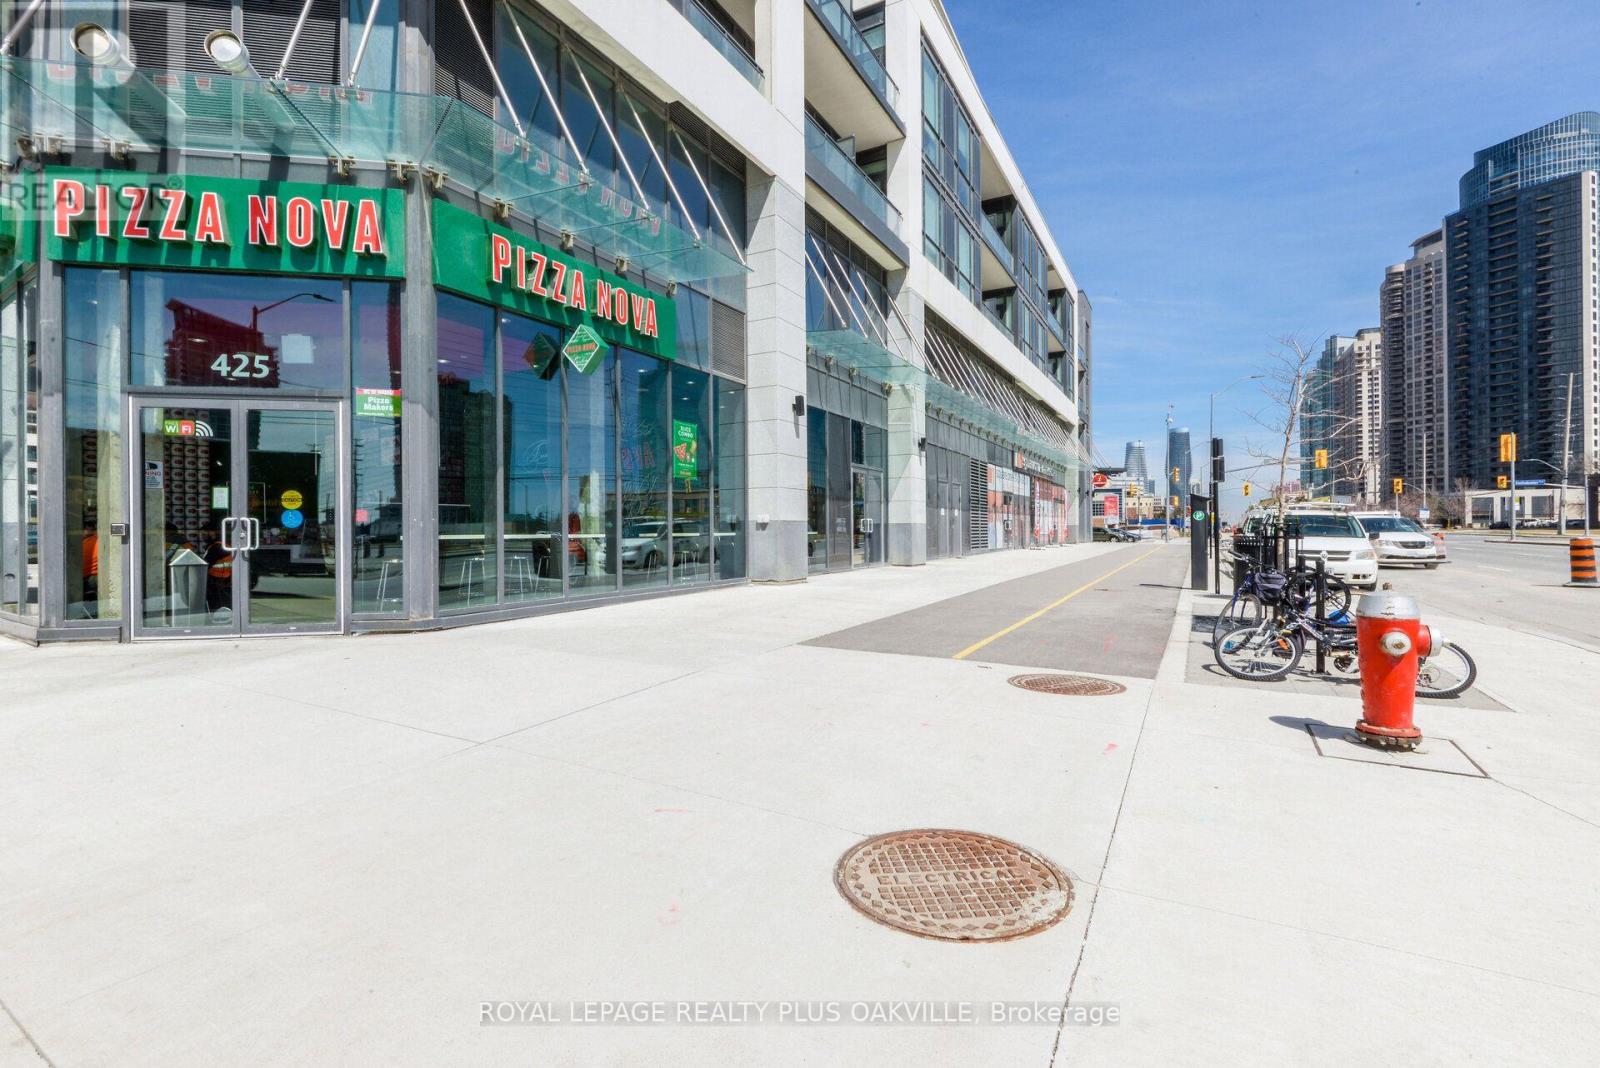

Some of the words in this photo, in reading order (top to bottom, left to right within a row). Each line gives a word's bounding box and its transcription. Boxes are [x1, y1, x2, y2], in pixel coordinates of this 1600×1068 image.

[53, 179, 225, 243] PIZZA
[248, 195, 383, 255] NOVA
[492, 233, 586, 311] PIZZA
[596, 279, 658, 338] NOVA
[210, 353, 270, 379] 425
[877, 868, 1024, 886] ELECTRICAL
